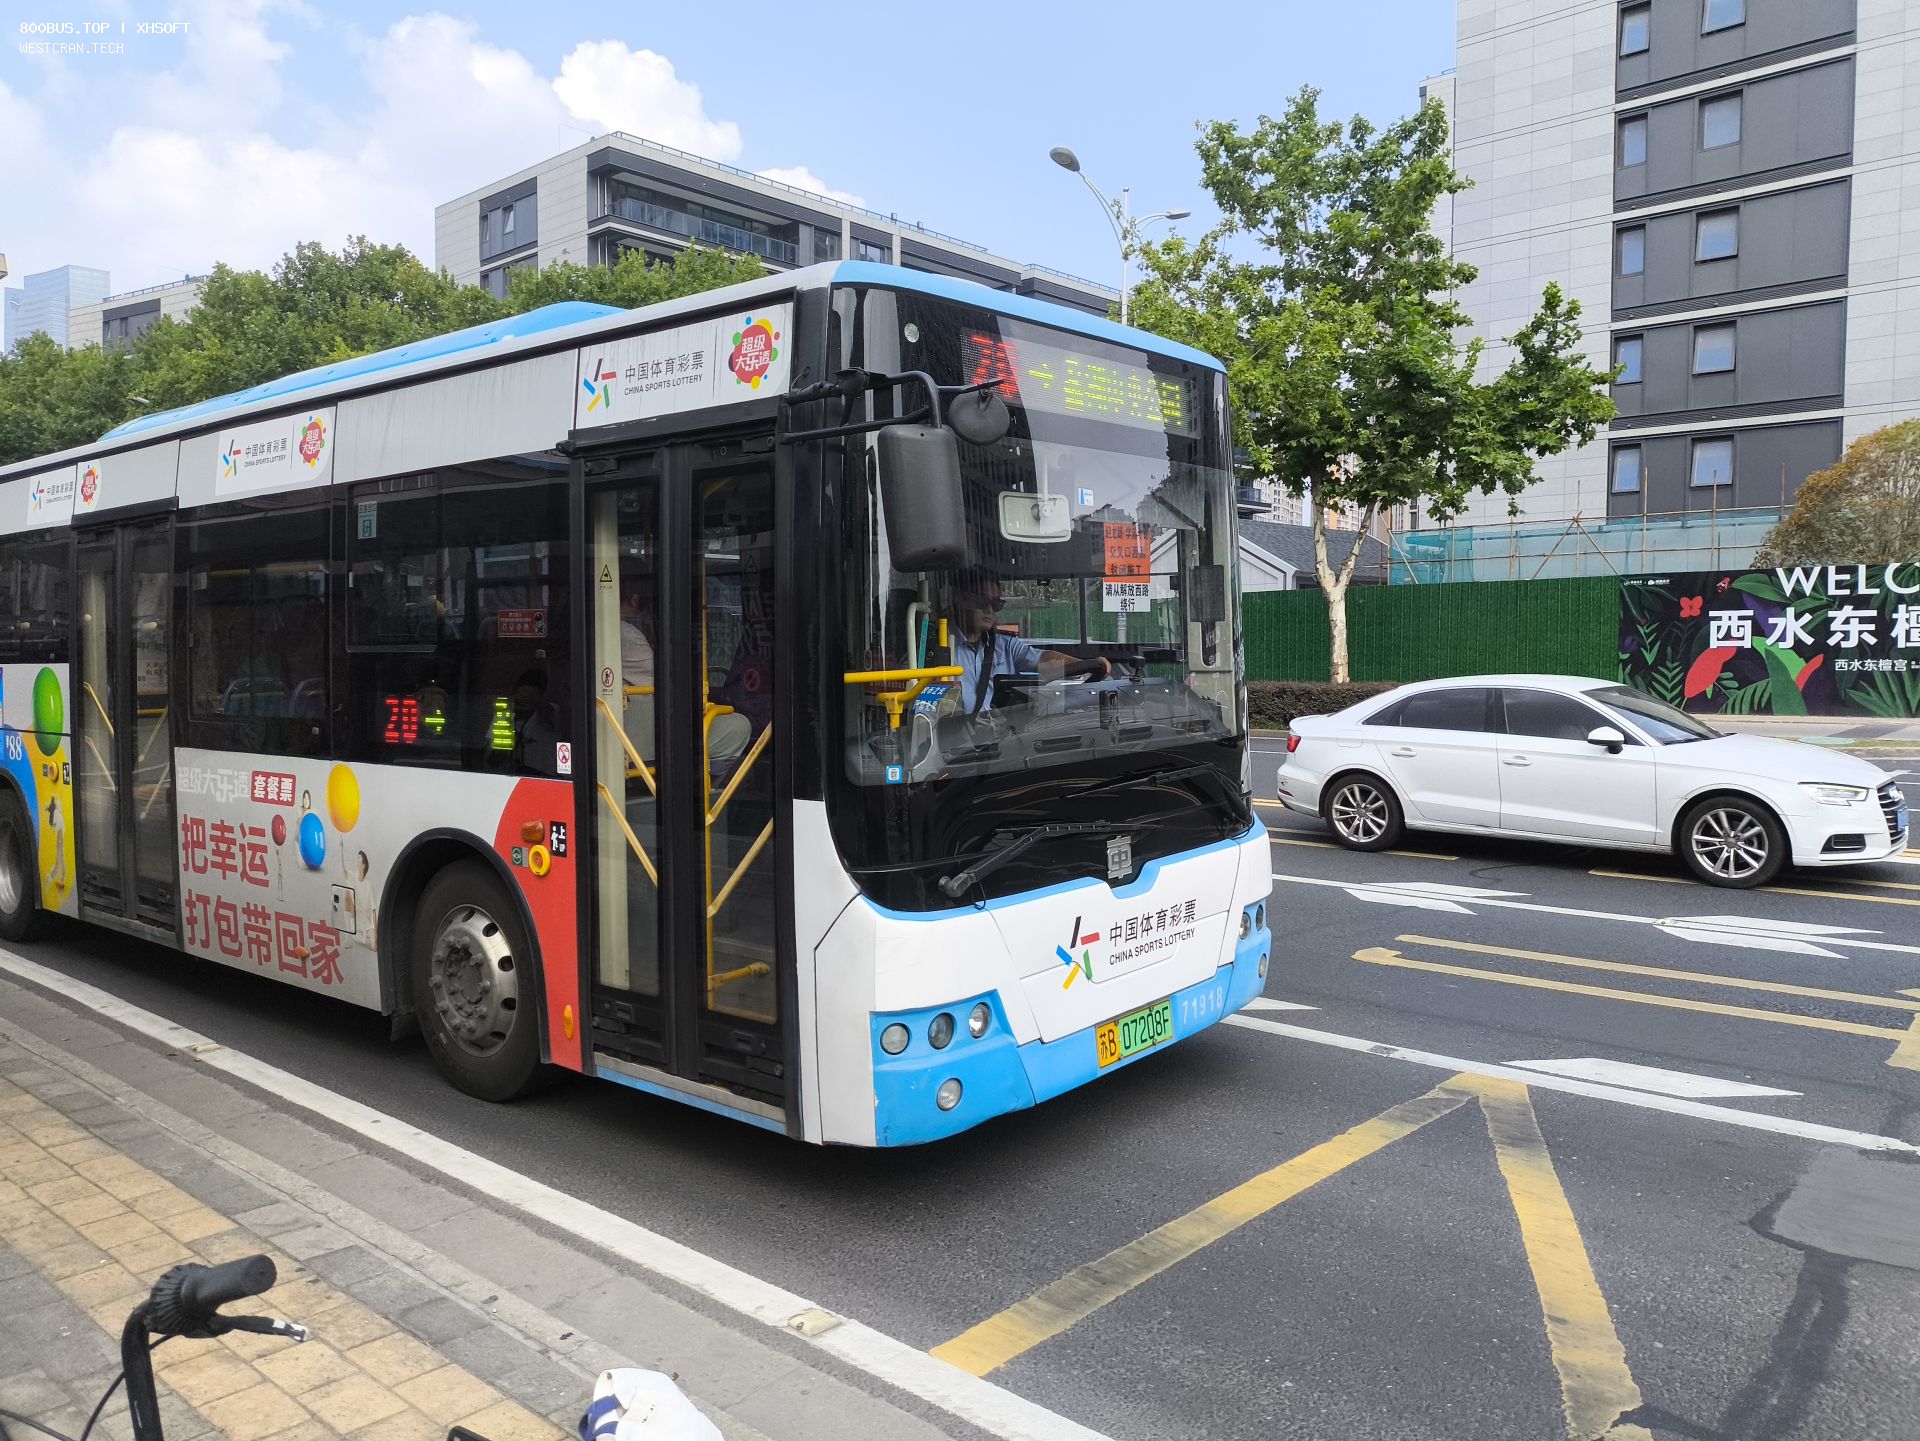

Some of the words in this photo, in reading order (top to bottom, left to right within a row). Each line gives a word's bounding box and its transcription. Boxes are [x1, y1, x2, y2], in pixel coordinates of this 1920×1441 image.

[741, 333, 766, 353] 超级
[625, 350, 705, 383] 中国体育彩票
[734, 350, 772, 372] 大乐透
[624, 385, 644, 396] CHINA
[645, 381, 671, 393] SPORTS
[672, 374, 703, 388] LOTTERY
[1105, 583, 1149, 597] 请从解放西路
[1120, 598, 1136, 612] 绕行
[1834, 658, 1908, 672] 西水东檀宫
[253, 775, 293, 802] 套餐票
[181, 814, 270, 888] 把幸运
[184, 889, 345, 985] 打包带回家
[1109, 899, 1197, 948] 中国体育彩票
[1109, 949, 1133, 965] CHINA
[1134, 941, 1163, 957] SPORTS
[1164, 928, 1195, 947] LOTTERY
[1182, 986, 1223, 1025] 71918
